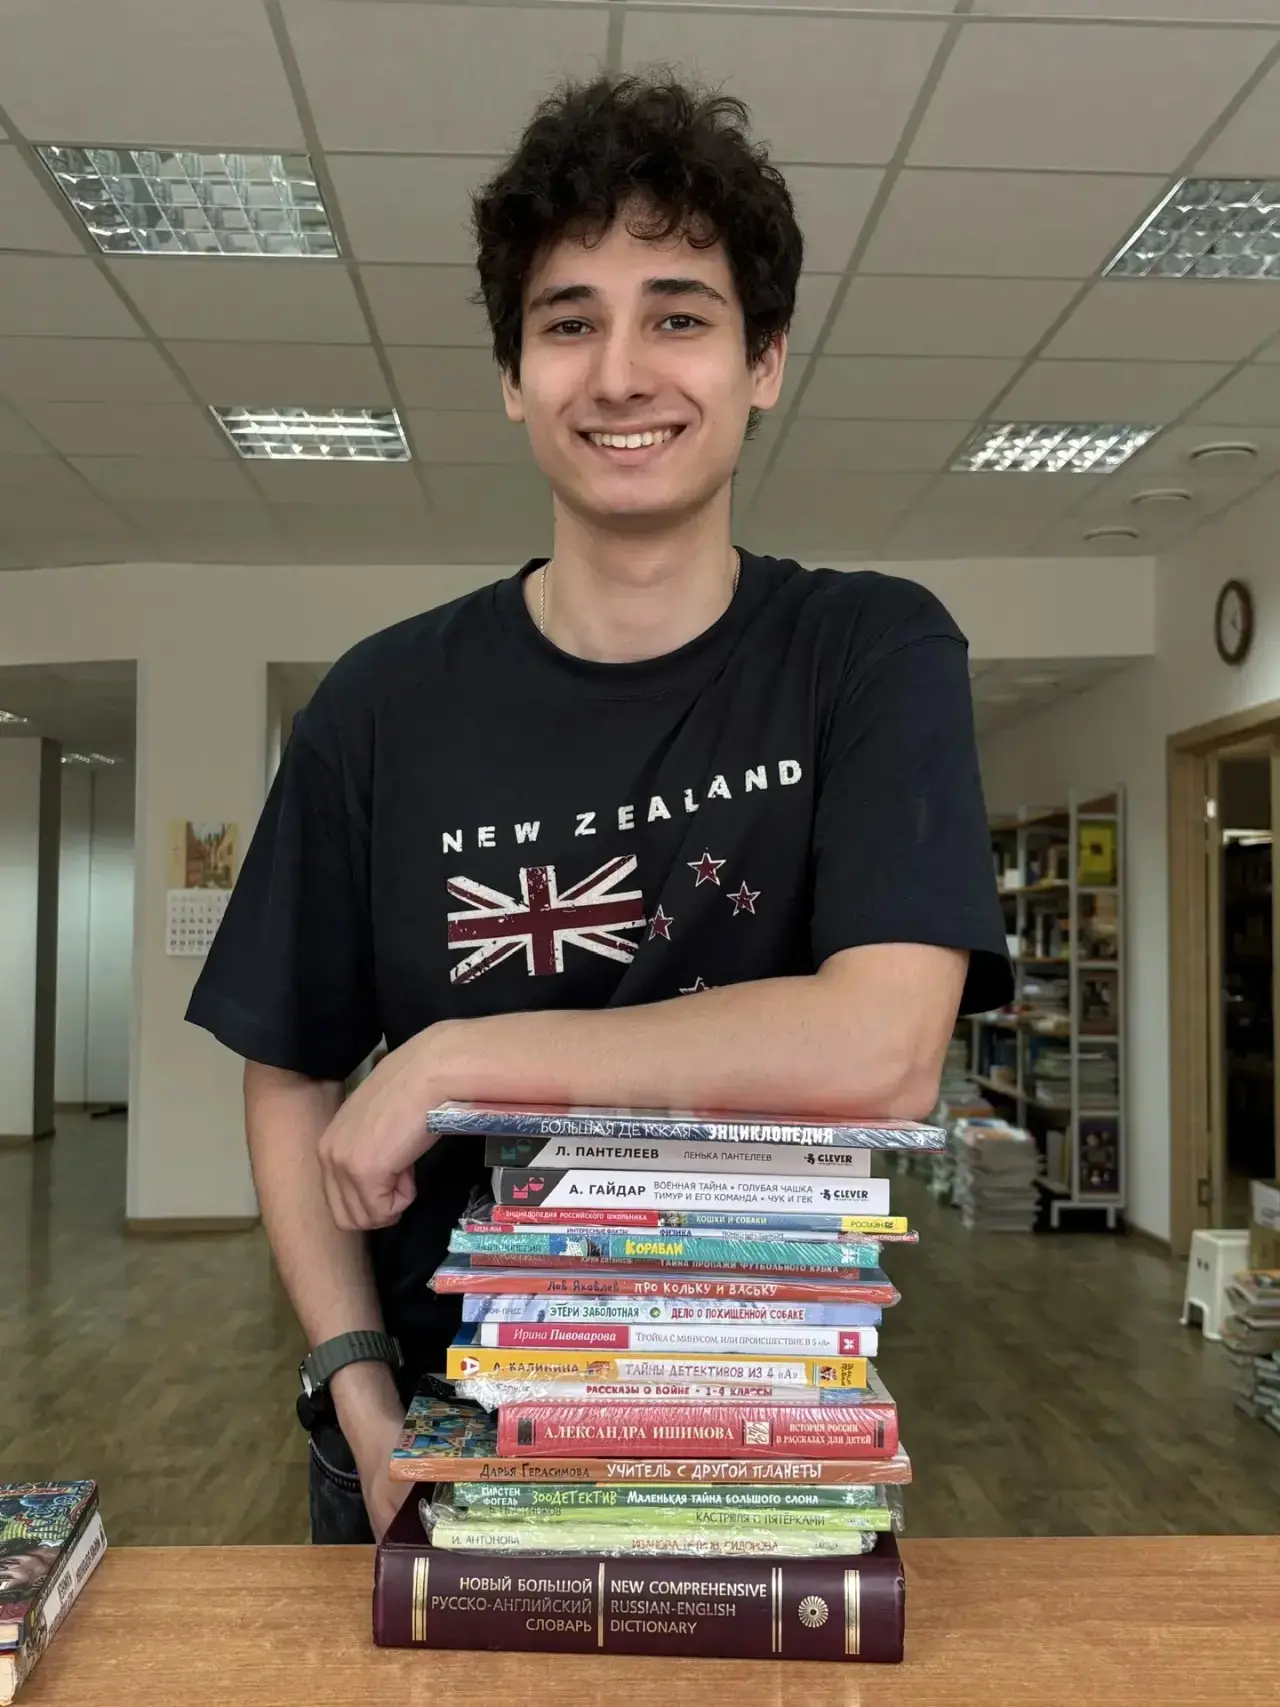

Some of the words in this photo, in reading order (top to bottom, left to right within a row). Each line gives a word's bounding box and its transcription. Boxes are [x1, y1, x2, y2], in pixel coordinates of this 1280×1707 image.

[442, 821, 541, 853] NEW
[574, 759, 803, 837] ZEALAND
[540, 1118, 615, 1137] БОЛЬШАЯ
[617, 1120, 692, 1139] ДЕТСКАЯ
[708, 1124, 834, 1145] ЭНЦИКЛОПЕДИЯ
[555, 1146, 571, 1158] Л.
[575, 1146, 660, 1160] ПАНТЕЛЕЕВ
[683, 1151, 718, 1161] ЛЕНЬКА
[721, 1152, 773, 1162] ПАНТЕЛЕЕВ
[817, 1154, 853, 1163] CLEVER
[569, 1184, 585, 1196] А.
[589, 1182, 646, 1197] ГАЙДАР
[653, 1181, 696, 1191] ВОЕННАЯ
[698, 1181, 728, 1192] ТАЙНА
[737, 1183, 779, 1193] ГОЛУБАЯ
[780, 1184, 813, 1194] ЧАШКА
[653, 1191, 683, 1201] ТИМУР
[685, 1193, 692, 1201] И
[695, 1193, 712, 1202] ЕГО
[714, 1193, 758, 1203] КОМАНДА
[767, 1195, 786, 1203] ЧУК
[797, 1196, 813, 1204] ГЕК
[833, 1190, 869, 1199] CLEVER
[505, 1210, 558, 1220] ЭНЦИКЛОПЕДИЯ
[559, 1211, 605, 1221] РОССИЙСКОГО
[606, 1212, 647, 1221] ШКОЛЬНИКА
[696, 1216, 726, 1224] КОШКИ
[727, 1216, 733, 1224] И
[735, 1216, 767, 1225] СОБАКИ
[850, 1221, 885, 1229] РОСМЭН
[659, 1229, 692, 1237] ФИЗИКА
[660, 1259, 690, 1268] ТАЙНА
[739, 1262, 806, 1271] ФУТБОЛЬНОГО
[547, 1280, 567, 1292] Лев
[572, 1280, 619, 1292] Яковлев
[663, 1282, 711, 1295] КОЛЬКУ
[716, 1285, 724, 1295] И
[729, 1285, 777, 1297] ВАСЬКУ
[549, 1306, 580, 1317] ЭТЕРИ
[582, 1306, 640, 1319] ЗАБОЛОТНАЯ
[671, 1307, 694, 1320] ДЕЛО
[696, 1308, 703, 1319] О
[705, 1306, 767, 1320] ПОХИЩЕННОЙ
[770, 1309, 805, 1320] СОБАКЕ
[513, 1329, 548, 1342] Ирина
[549, 1329, 617, 1343] Пивоварова
[669, 1335, 675, 1343] С
[720, 1336, 738, 1345] ИЛИ
[739, 1337, 804, 1346] ПРОИСШЕСТВИЕ
[493, 1362, 507, 1372] А.
[509, 1362, 579, 1373] КАЛИНИНА
[625, 1362, 665, 1376] ТАЙНЫ
[668, 1365, 744, 1379] ДЕТЕКТИВОВ
[748, 1367, 762, 1378] ИЗ
[766, 1367, 774, 1378] 4
[777, 1368, 799, 1379] «А»
[586, 1385, 640, 1395] РАССКАЗЫ
[643, 1386, 651, 1395] О
[655, 1385, 690, 1396] ВОЙНЕ
[705, 1387, 725, 1396] 1-4
[729, 1388, 773, 1397] КЛАССЫ
[544, 1426, 646, 1441] АЛЕКСАНДРА
[652, 1426, 735, 1440] ИШИМОВА
[789, 1423, 826, 1433] ИСТОРИЯ
[776, 1435, 782, 1444] В
[783, 1435, 827, 1445] РАССКАЗАХ
[827, 1435, 845, 1445] ДЛЯ
[846, 1434, 872, 1446] ДЕТЕЙ
[607, 1463, 671, 1478] УЧИТЕЛЬ
[677, 1465, 687, 1477] С
[691, 1462, 748, 1480] ДРУГОЙ
[752, 1464, 822, 1479] ПЛАНЕТЫ
[481, 1487, 521, 1497] КИРСТЕН
[484, 1496, 519, 1506] ФОГЕЛЬ
[696, 1512, 750, 1524] КАСТРЮЛЯ
[764, 1513, 826, 1526] ПЯТЁРКАМИ
[451, 1536, 461, 1545] И.
[465, 1535, 521, 1546] АНТОНОВА
[459, 1575, 512, 1592] НОВЫЙ
[518, 1578, 593, 1595] БОЛЬШОЙ
[610, 1579, 644, 1594] NEW
[649, 1580, 768, 1598] COMPREHENSIVE
[431, 1596, 592, 1615] РУССКО-АНГЛИЙСКИЙ
[610, 1600, 736, 1617] RUSSIAN-ENGLISH
[525, 1618, 592, 1633] СЛОВАРЬ
[610, 1620, 698, 1635] DICTIONARY
